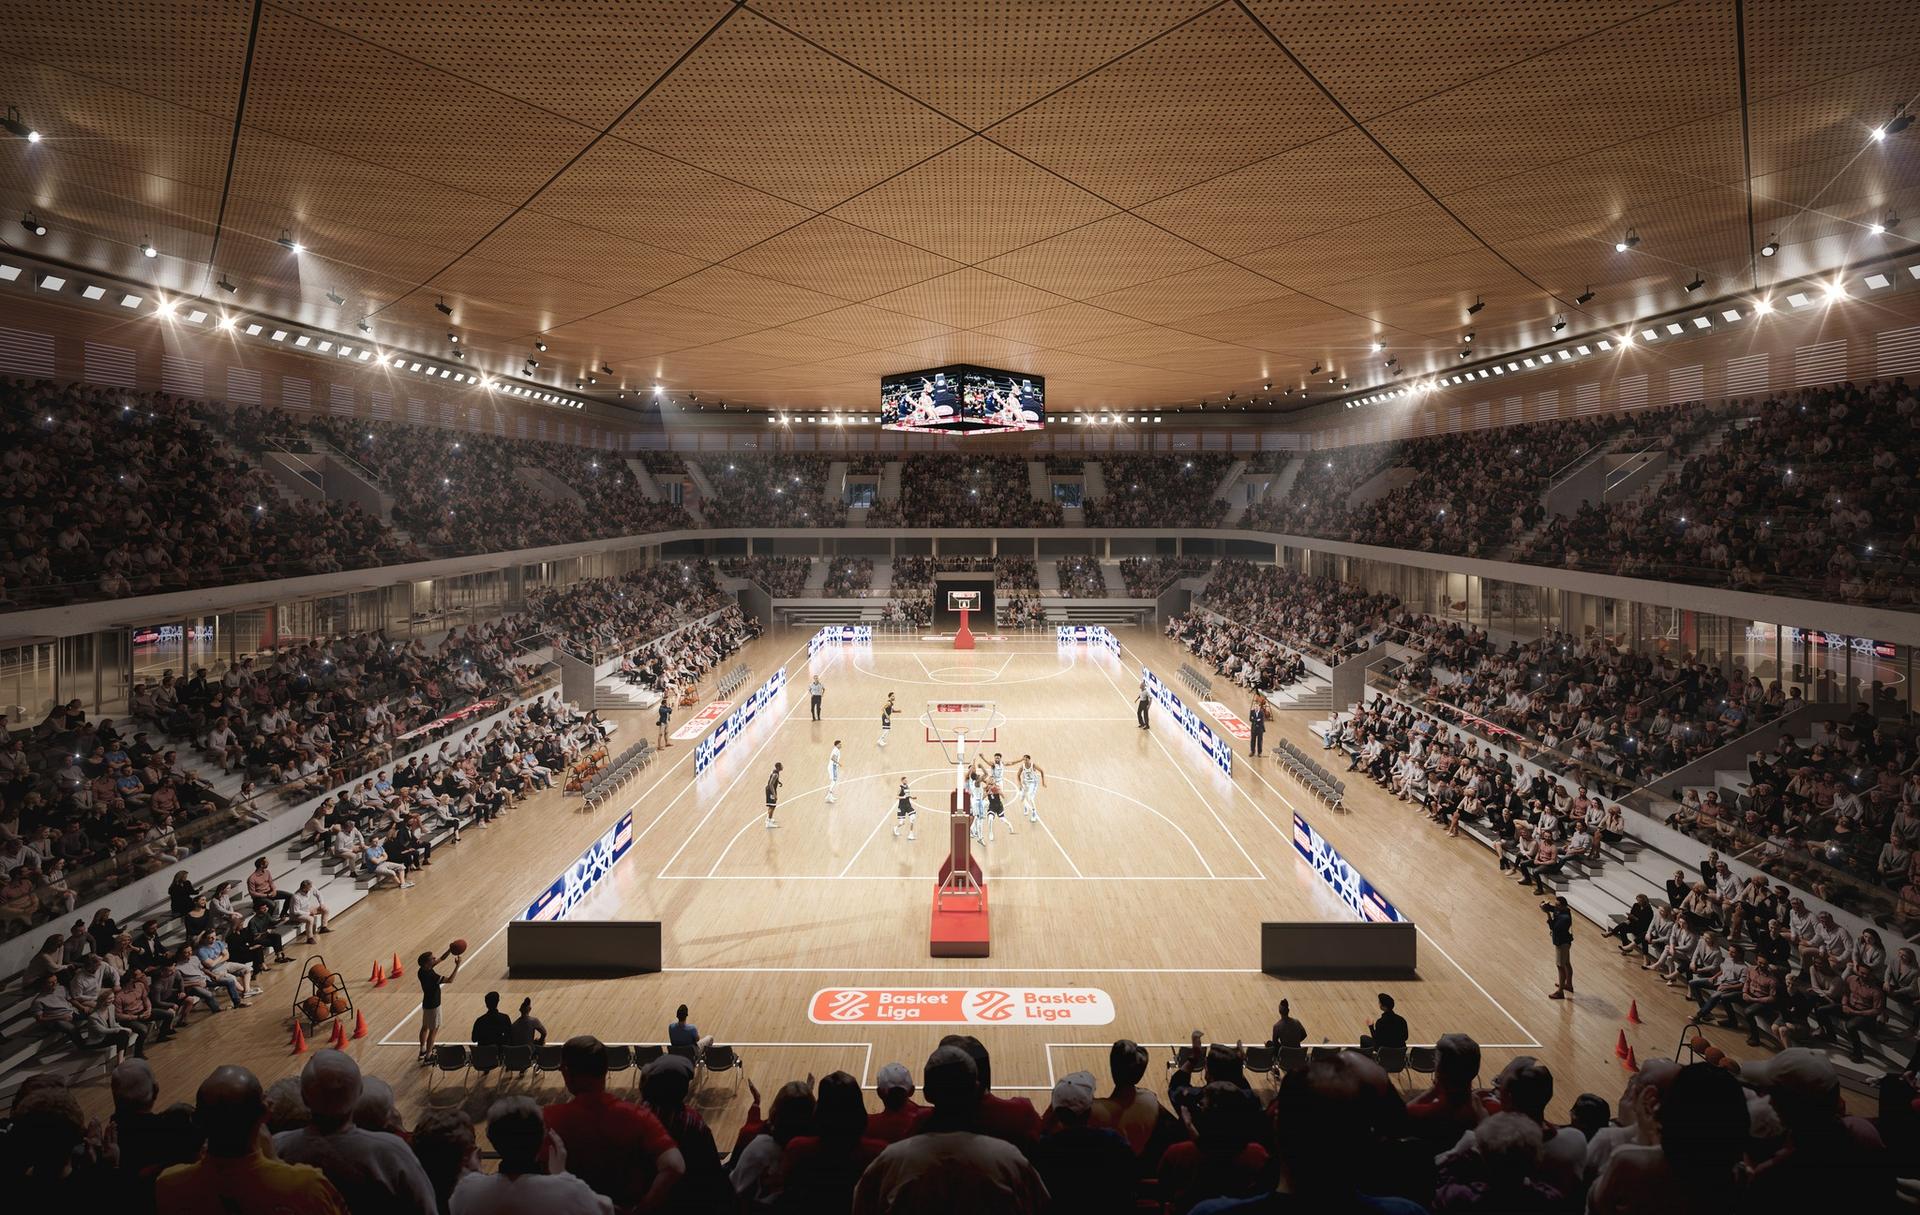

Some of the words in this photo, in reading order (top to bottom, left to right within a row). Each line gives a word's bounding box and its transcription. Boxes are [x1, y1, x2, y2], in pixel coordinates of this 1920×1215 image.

[879, 992, 949, 1004] Basket
[1023, 992, 1097, 1004] Basket
[877, 1005, 921, 1021] Liga
[1025, 1006, 1071, 1021] Liga
